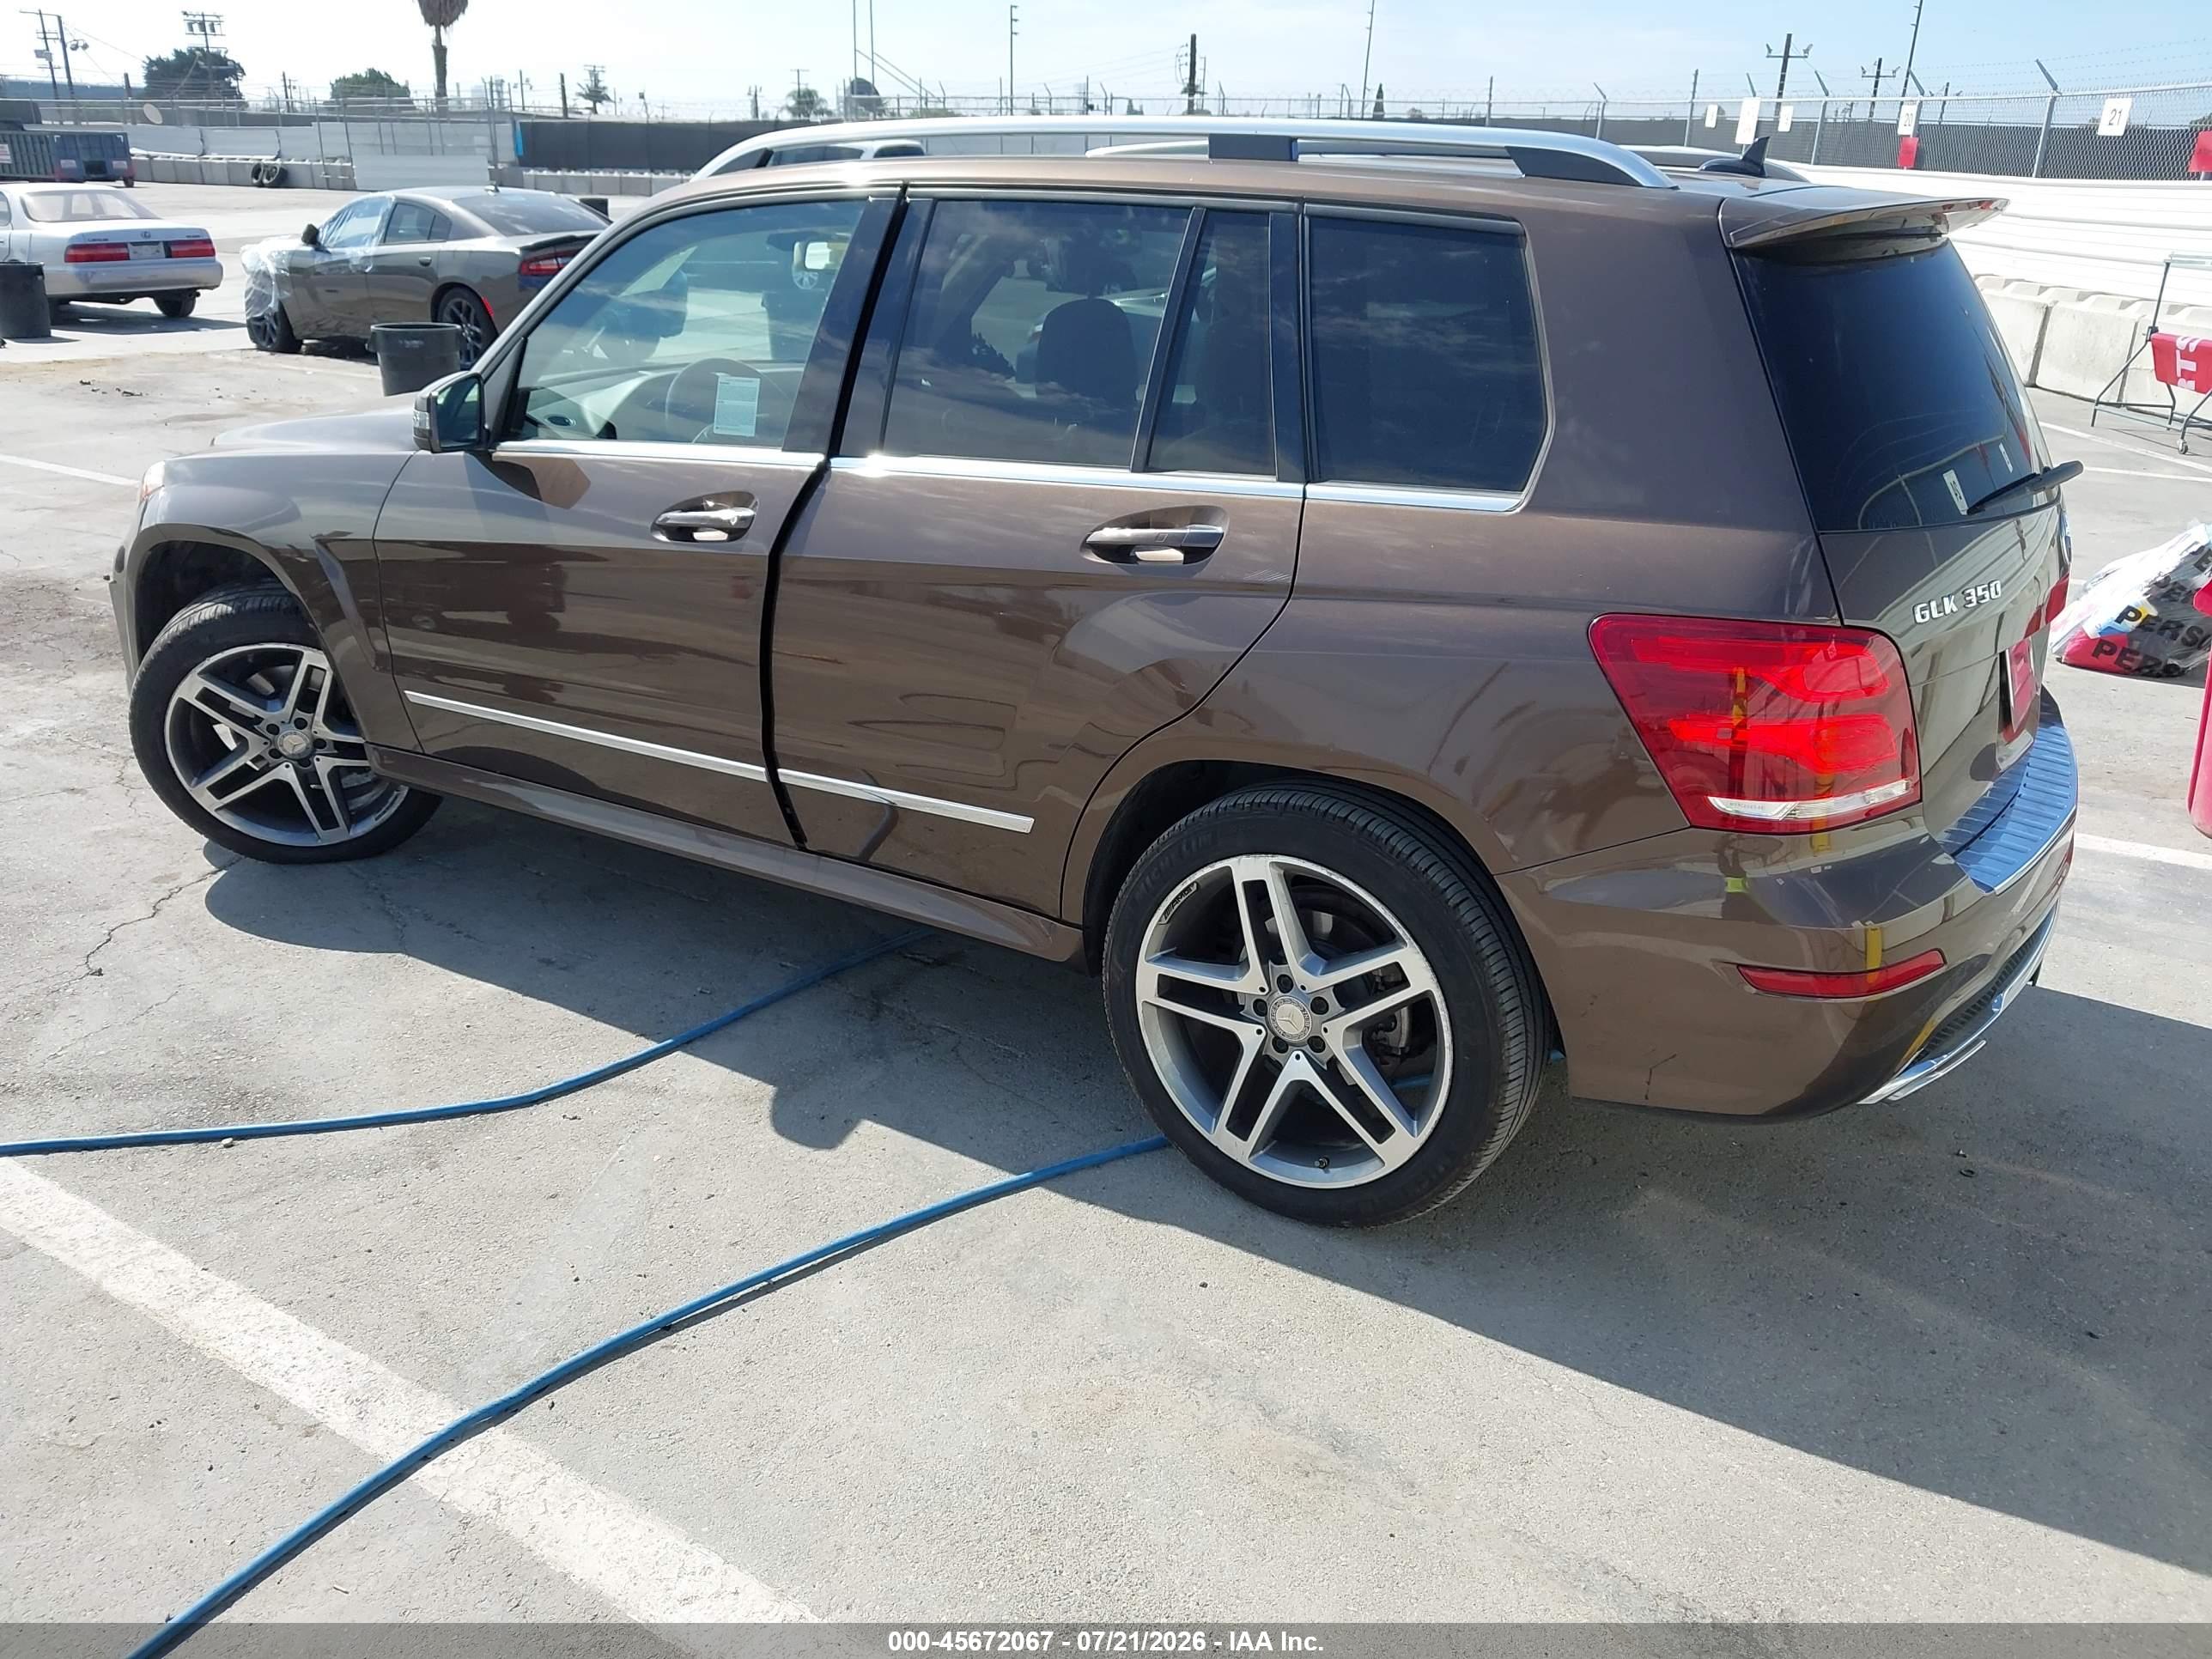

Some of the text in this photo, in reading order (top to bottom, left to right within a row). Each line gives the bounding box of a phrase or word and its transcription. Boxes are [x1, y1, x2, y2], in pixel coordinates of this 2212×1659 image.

[1903, 112, 1914, 127] 20
[2108, 108, 2124, 126] 21
[1912, 580, 2002, 624] GLK 350
